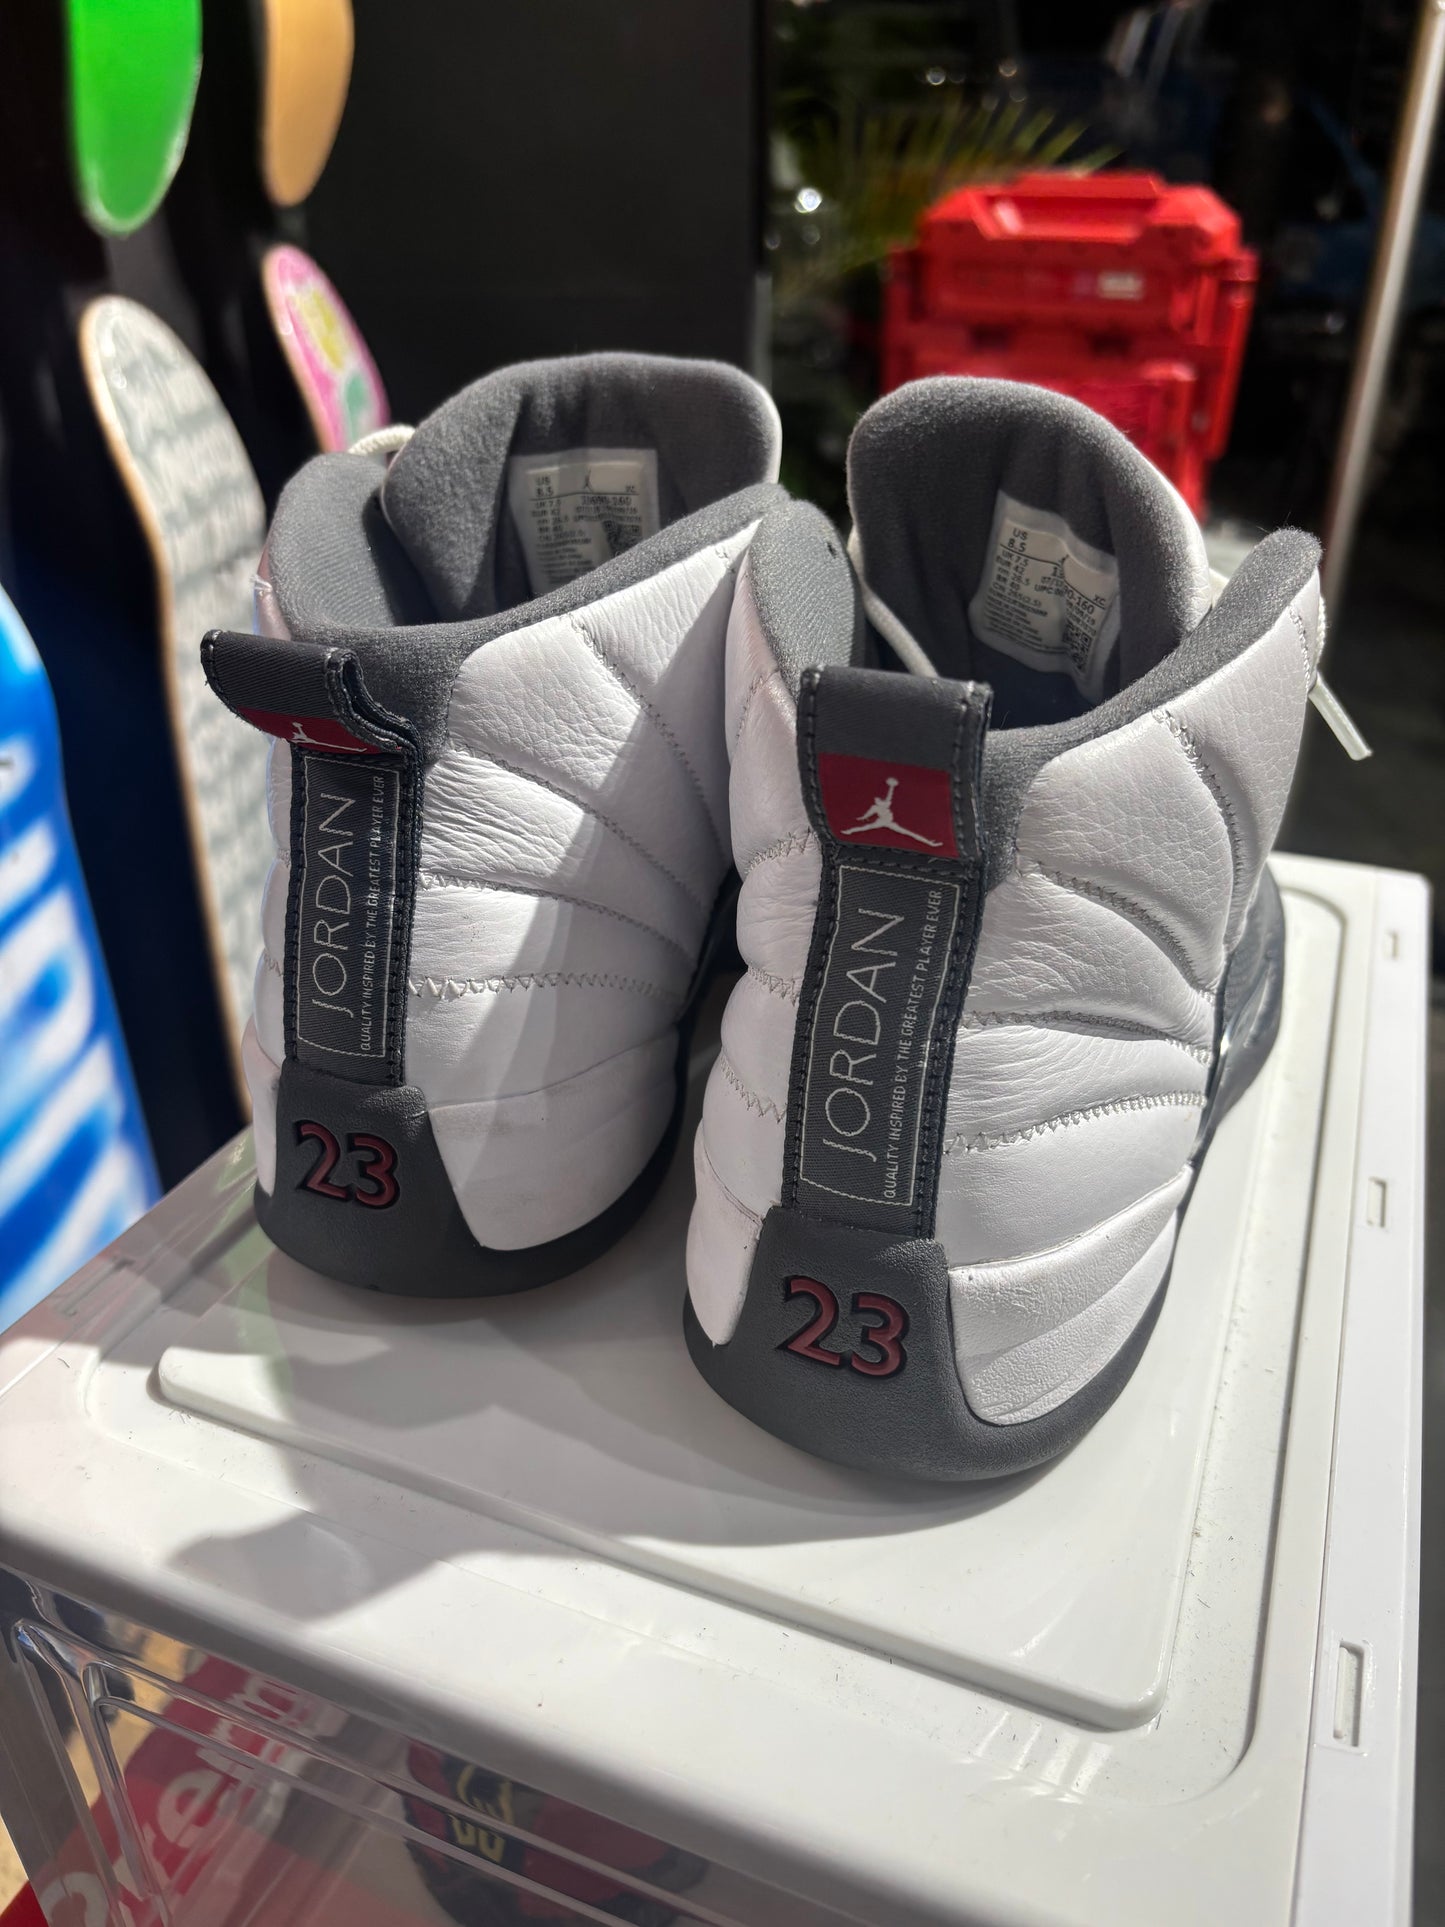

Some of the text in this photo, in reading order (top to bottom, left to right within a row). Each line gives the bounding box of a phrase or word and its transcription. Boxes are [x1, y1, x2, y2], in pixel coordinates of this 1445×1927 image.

[1007, 538, 1027, 552] 8.5
[1012, 528, 1028, 541] US
[1013, 555, 1029, 567] 7.5
[369, 805, 382, 847] PLAYER
[367, 850, 380, 906] GREATEST
[312, 792, 356, 1018] JORDAN
[365, 909, 376, 928] THE
[365, 931, 376, 947] BY
[915, 922, 937, 972] PLAYER
[362, 951, 375, 998] INSPIRED
[360, 1001, 371, 1050] QUALITY
[902, 975, 925, 1036] GREATEST
[822, 907, 904, 1161] JORDAN
[897, 1037, 912, 1061] THE
[895, 1064, 908, 1082] BY
[888, 1084, 905, 1140] INSPIRED
[294, 1120, 399, 1209] 23
[882, 1144, 898, 1199] QUALITY
[776, 1275, 909, 1378] 23
